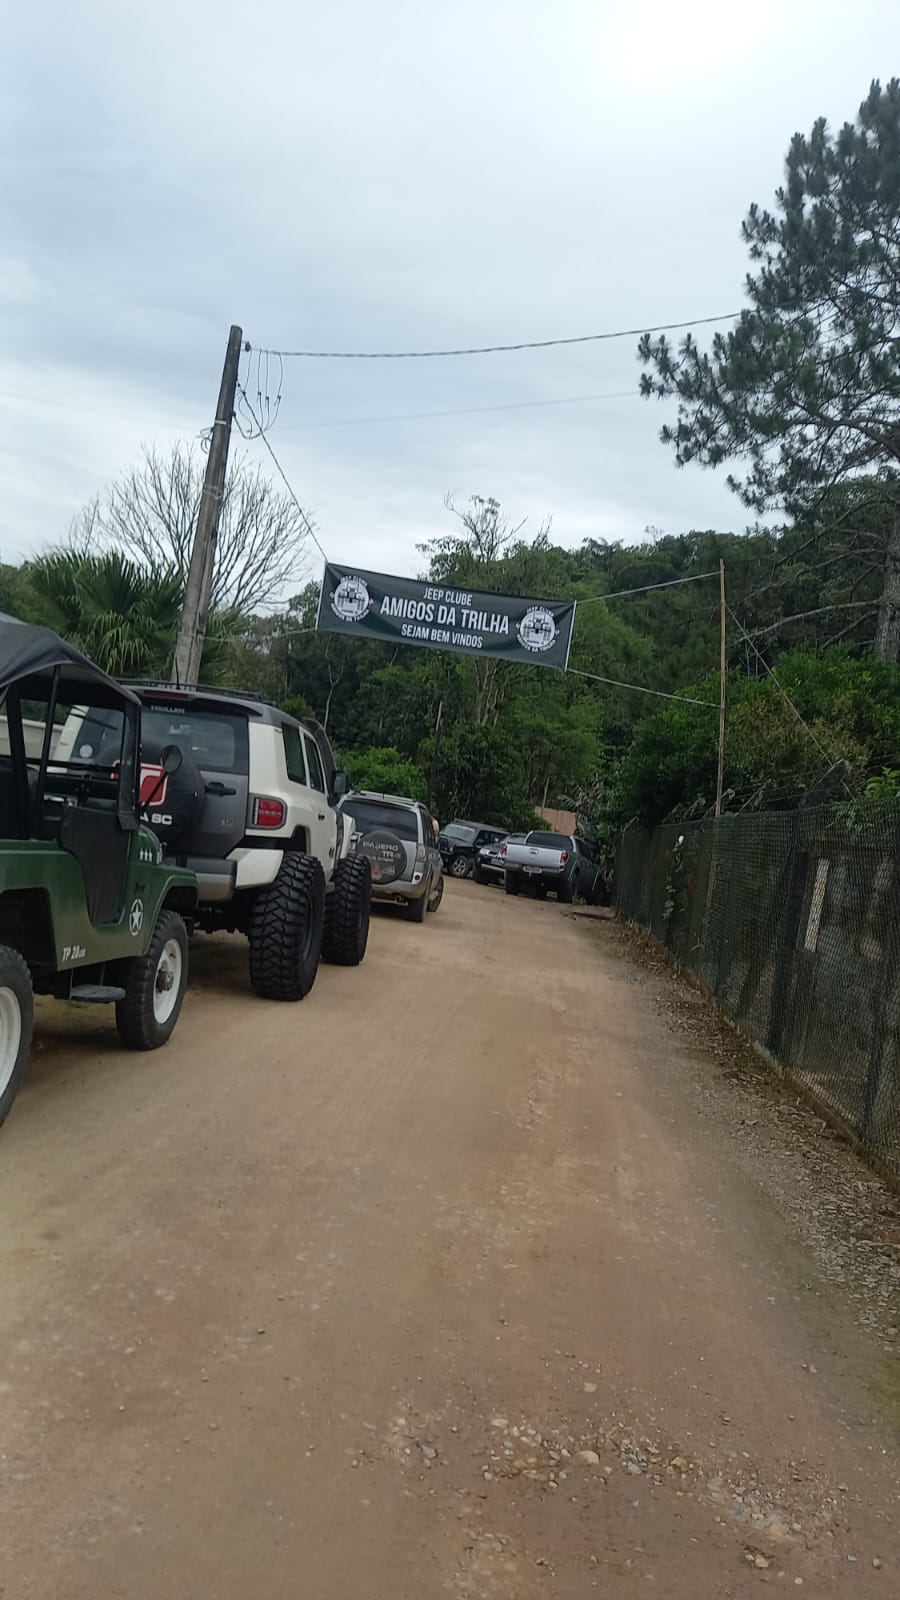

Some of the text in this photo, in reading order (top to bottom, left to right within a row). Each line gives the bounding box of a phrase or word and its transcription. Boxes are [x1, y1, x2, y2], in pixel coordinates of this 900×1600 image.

[423, 587, 473, 607] JEEP CLUBE
[380, 596, 435, 622] AMIGOS
[437, 605, 456, 627] DA
[461, 608, 509, 635] TRILHA
[401, 623, 484, 649] SEJAM BEM VINDOS
[151, 812, 173, 825] SC
[362, 841, 399, 851] PAJERO
